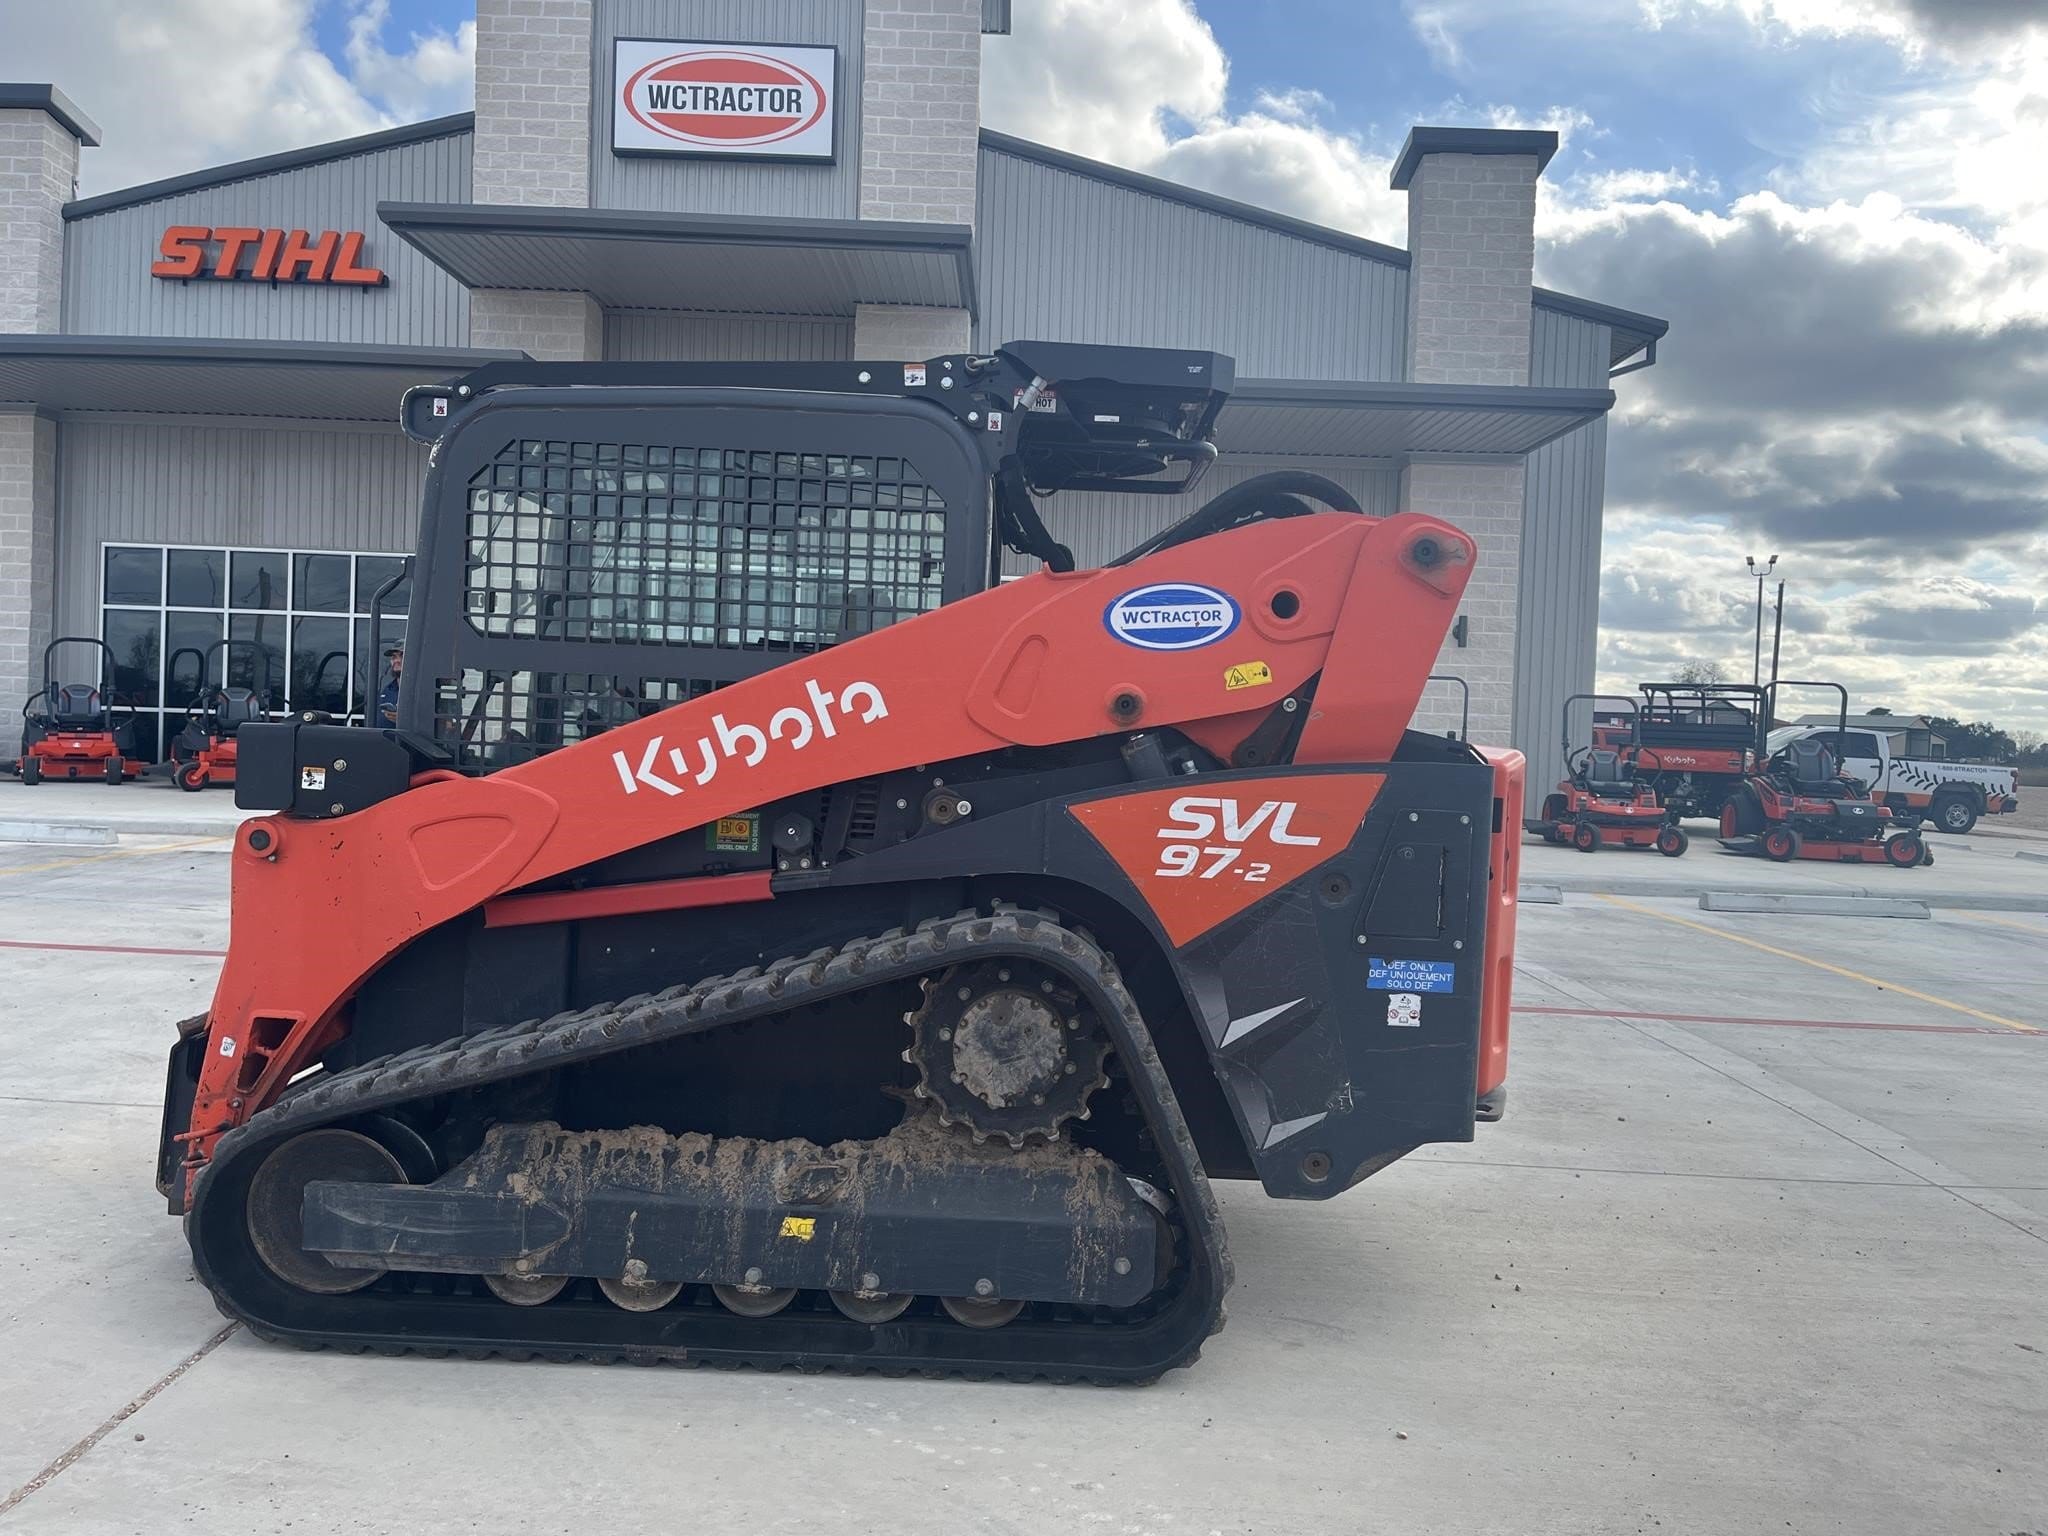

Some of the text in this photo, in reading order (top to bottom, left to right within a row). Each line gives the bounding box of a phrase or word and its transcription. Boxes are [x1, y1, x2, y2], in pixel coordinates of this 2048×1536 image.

[648, 84, 802, 113] WCTRACTOR
[151, 225, 385, 284] STIHL
[1035, 398, 1053, 408] HOT
[612, 679, 889, 797] Kubota
[1663, 755, 1696, 764] Kubota
[1156, 797, 1321, 846] SVL
[1155, 844, 1271, 882] 97-2
[1369, 969, 1452, 981] DEF UNIQUEMENT
[1387, 961, 1435, 972] DEF ONLY
[1386, 979, 1434, 990] SOLO DEF
